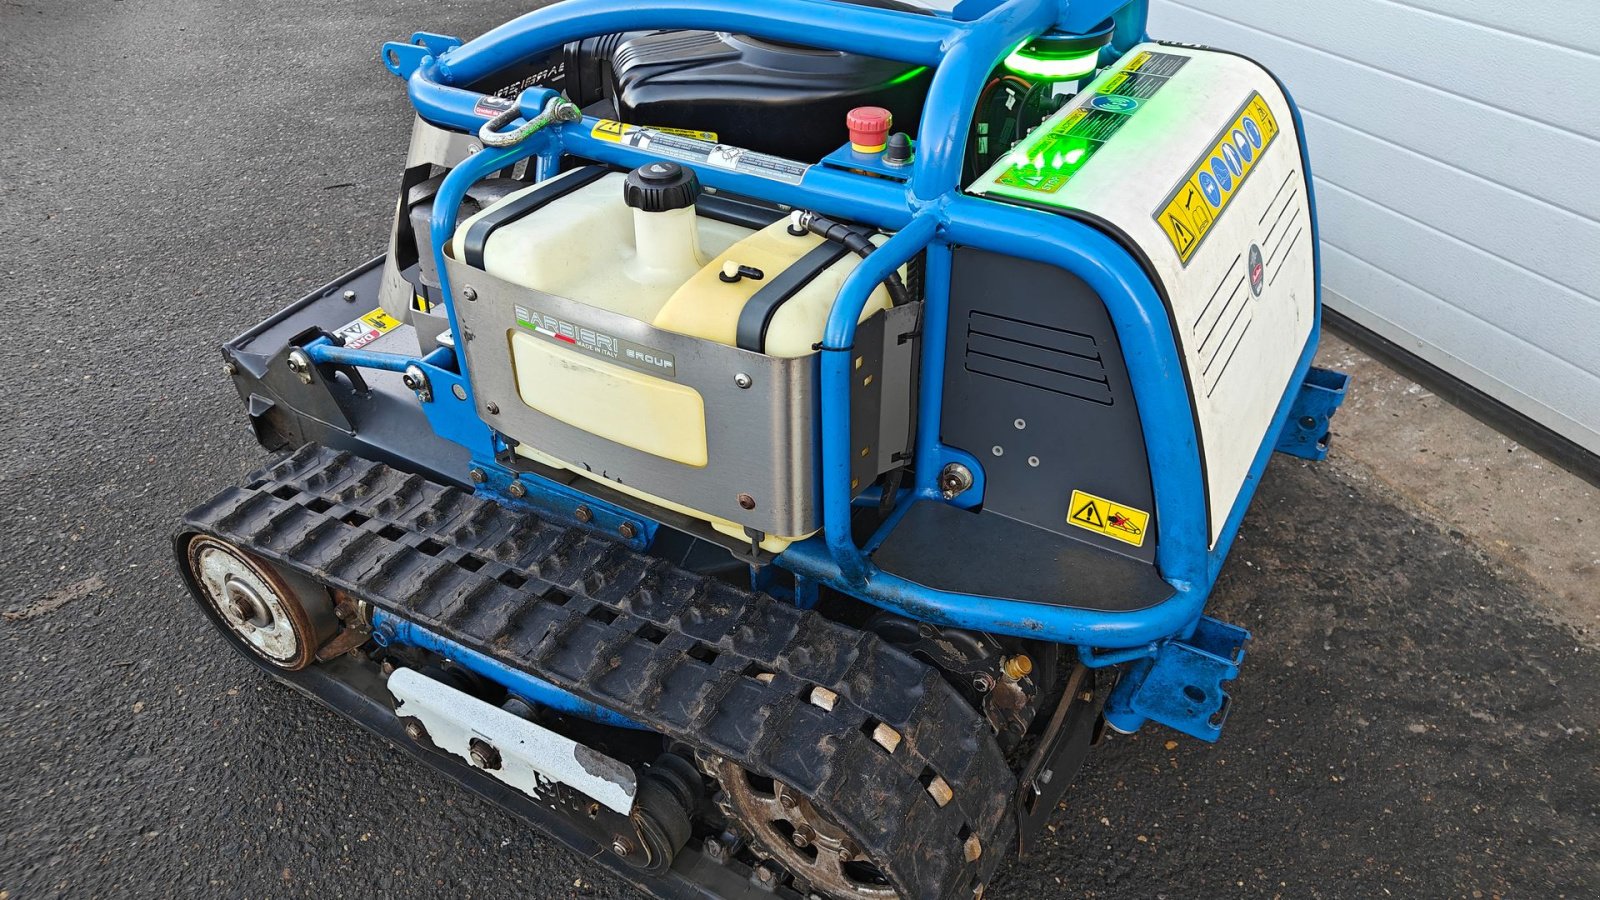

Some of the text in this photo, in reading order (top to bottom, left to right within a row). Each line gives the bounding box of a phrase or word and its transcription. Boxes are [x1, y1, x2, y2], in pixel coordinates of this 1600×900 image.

[515, 305, 618, 352] BARBIERI
[576, 341, 593, 351] MADE
[602, 348, 618, 359] ITALY
[626, 348, 673, 368] GROUP
